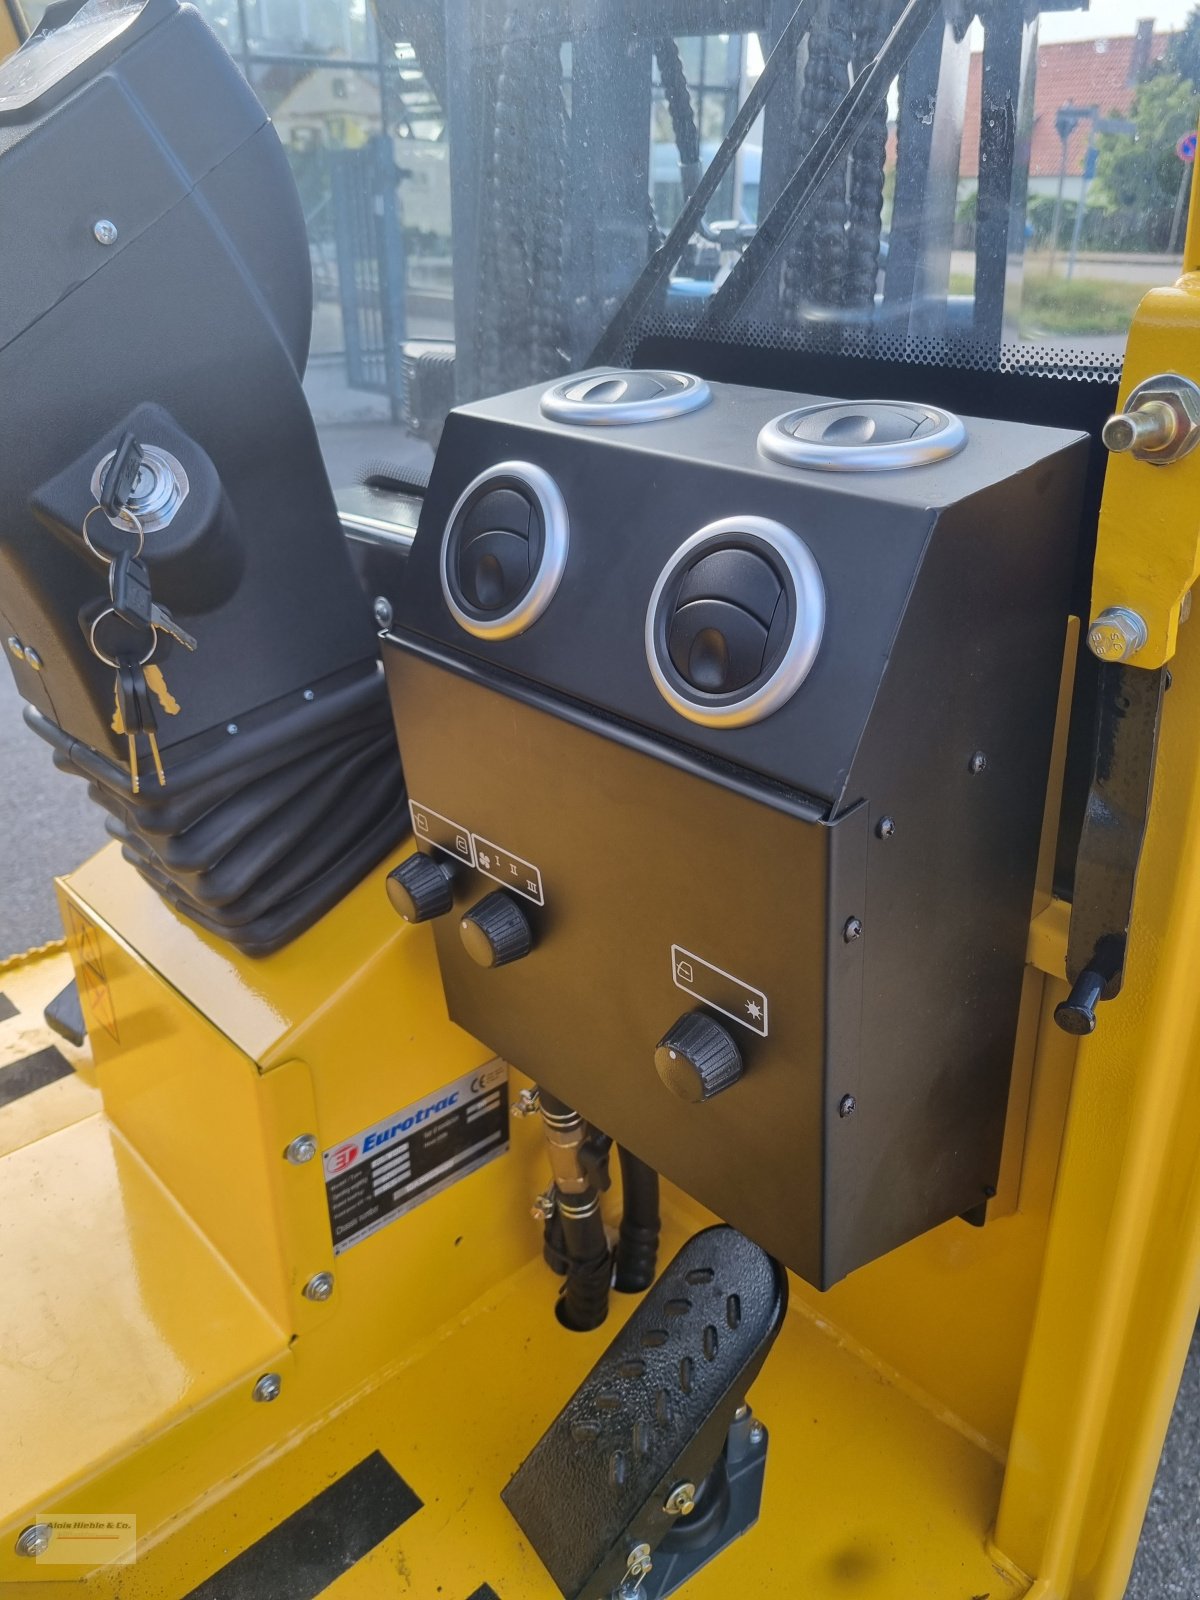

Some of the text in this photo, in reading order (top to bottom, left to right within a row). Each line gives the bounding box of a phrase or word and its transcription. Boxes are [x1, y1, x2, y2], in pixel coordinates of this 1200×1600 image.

[509, 864, 518, 876] II
[526, 880, 538, 894] III
[470, 1074, 486, 1093] CE
[362, 1091, 459, 1153] Eurotrac
